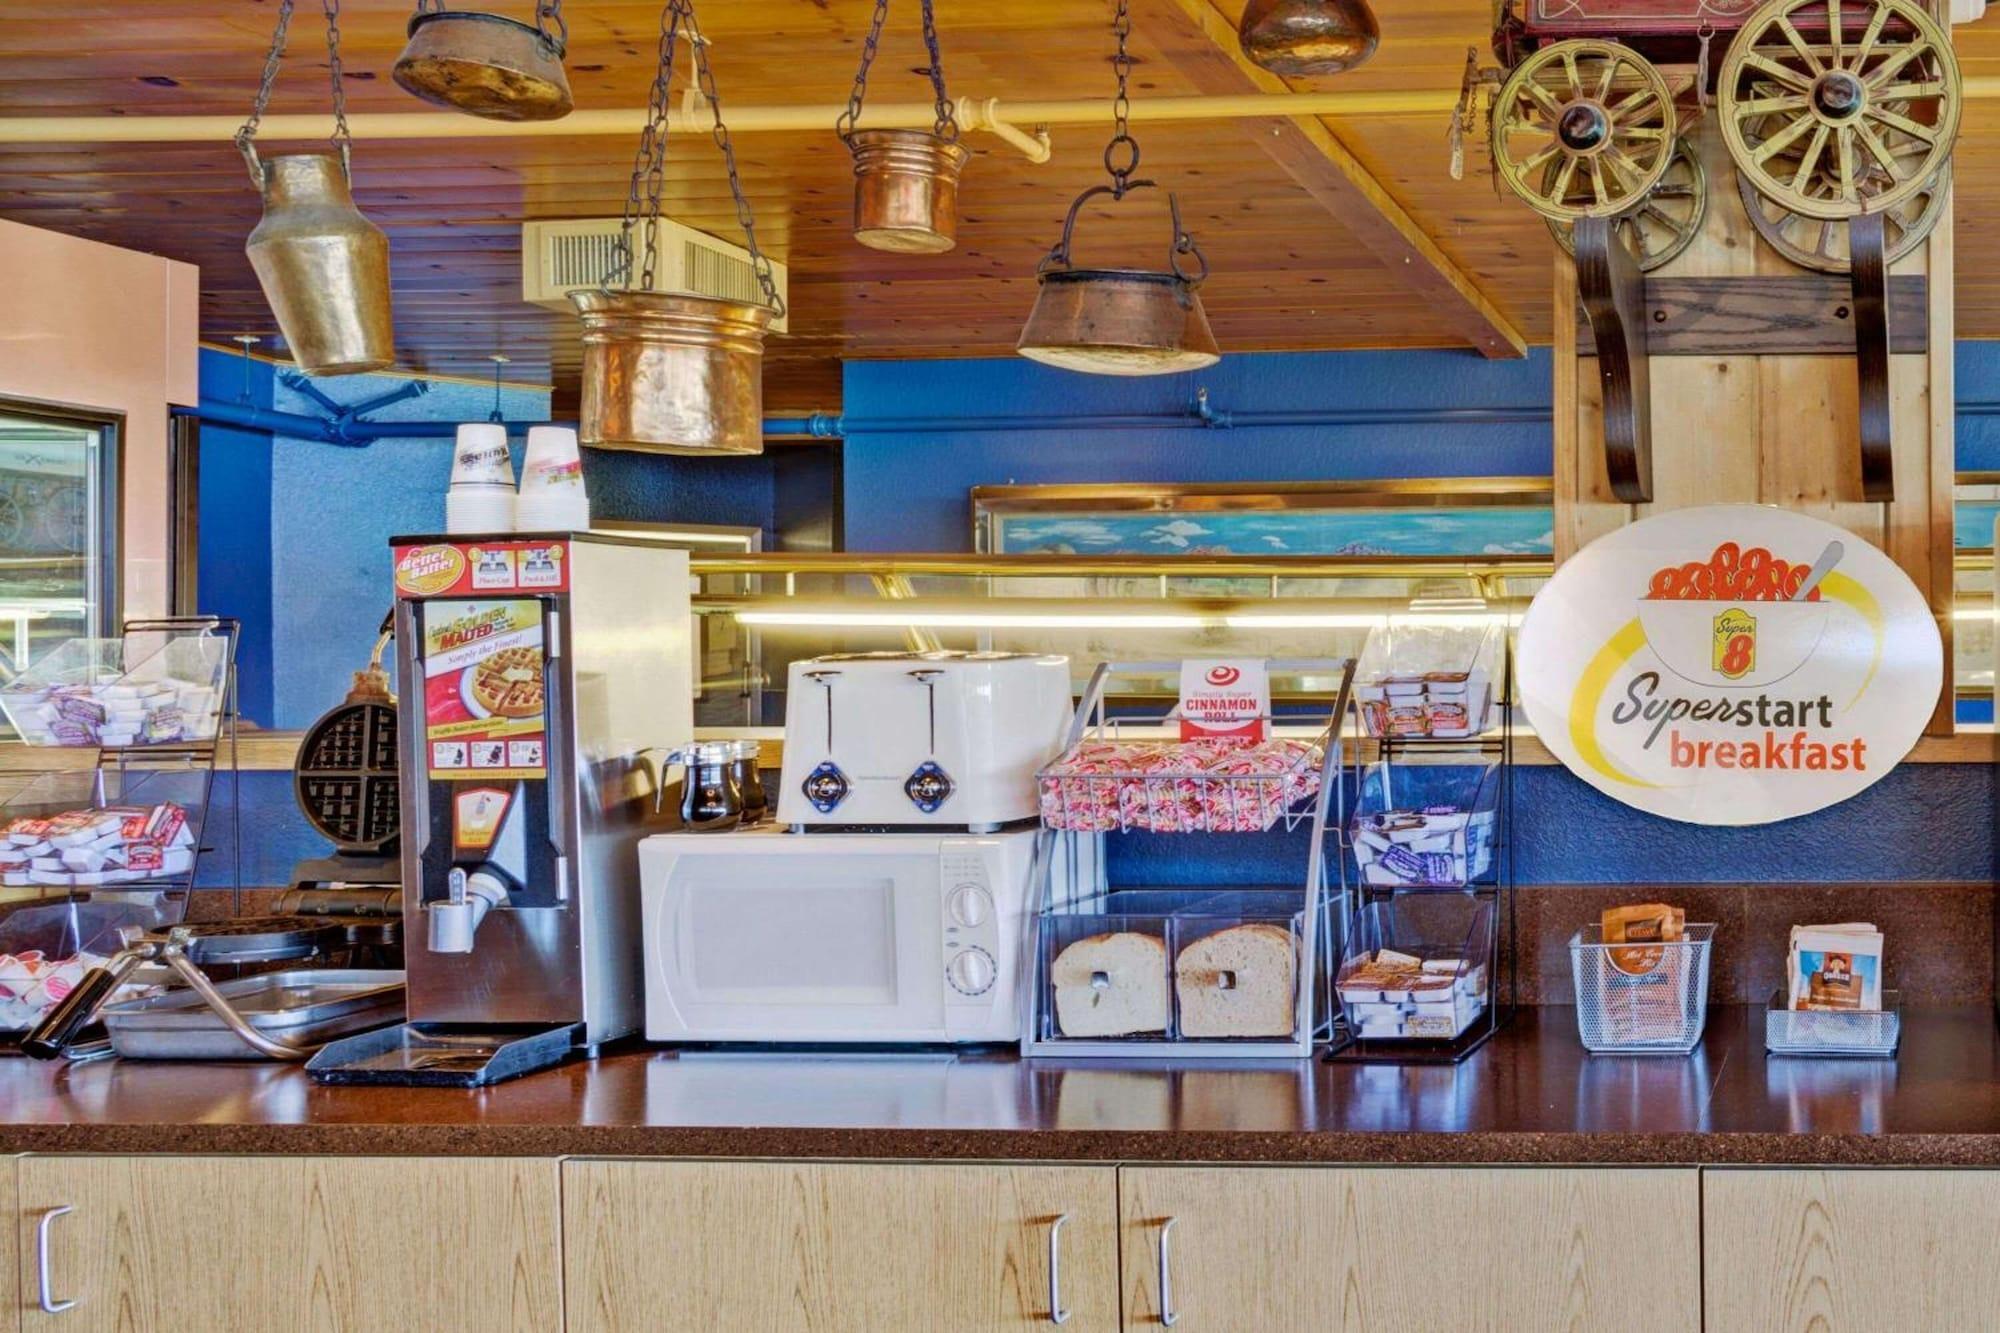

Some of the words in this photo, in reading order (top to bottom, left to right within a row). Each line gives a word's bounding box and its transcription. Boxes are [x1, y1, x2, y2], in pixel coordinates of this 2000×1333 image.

[401, 549, 446, 570] Better
[440, 623, 493, 649] MALTED
[1716, 617, 1753, 640] Super
[448, 650, 477, 664] Simply
[479, 645, 493, 655] the
[1721, 634, 1754, 675] 8
[1186, 699, 1257, 711] CINNAMON
[1612, 671, 1833, 750] Superstart
[1204, 711, 1239, 723] ROLL
[1670, 730, 1867, 771] breakfast
